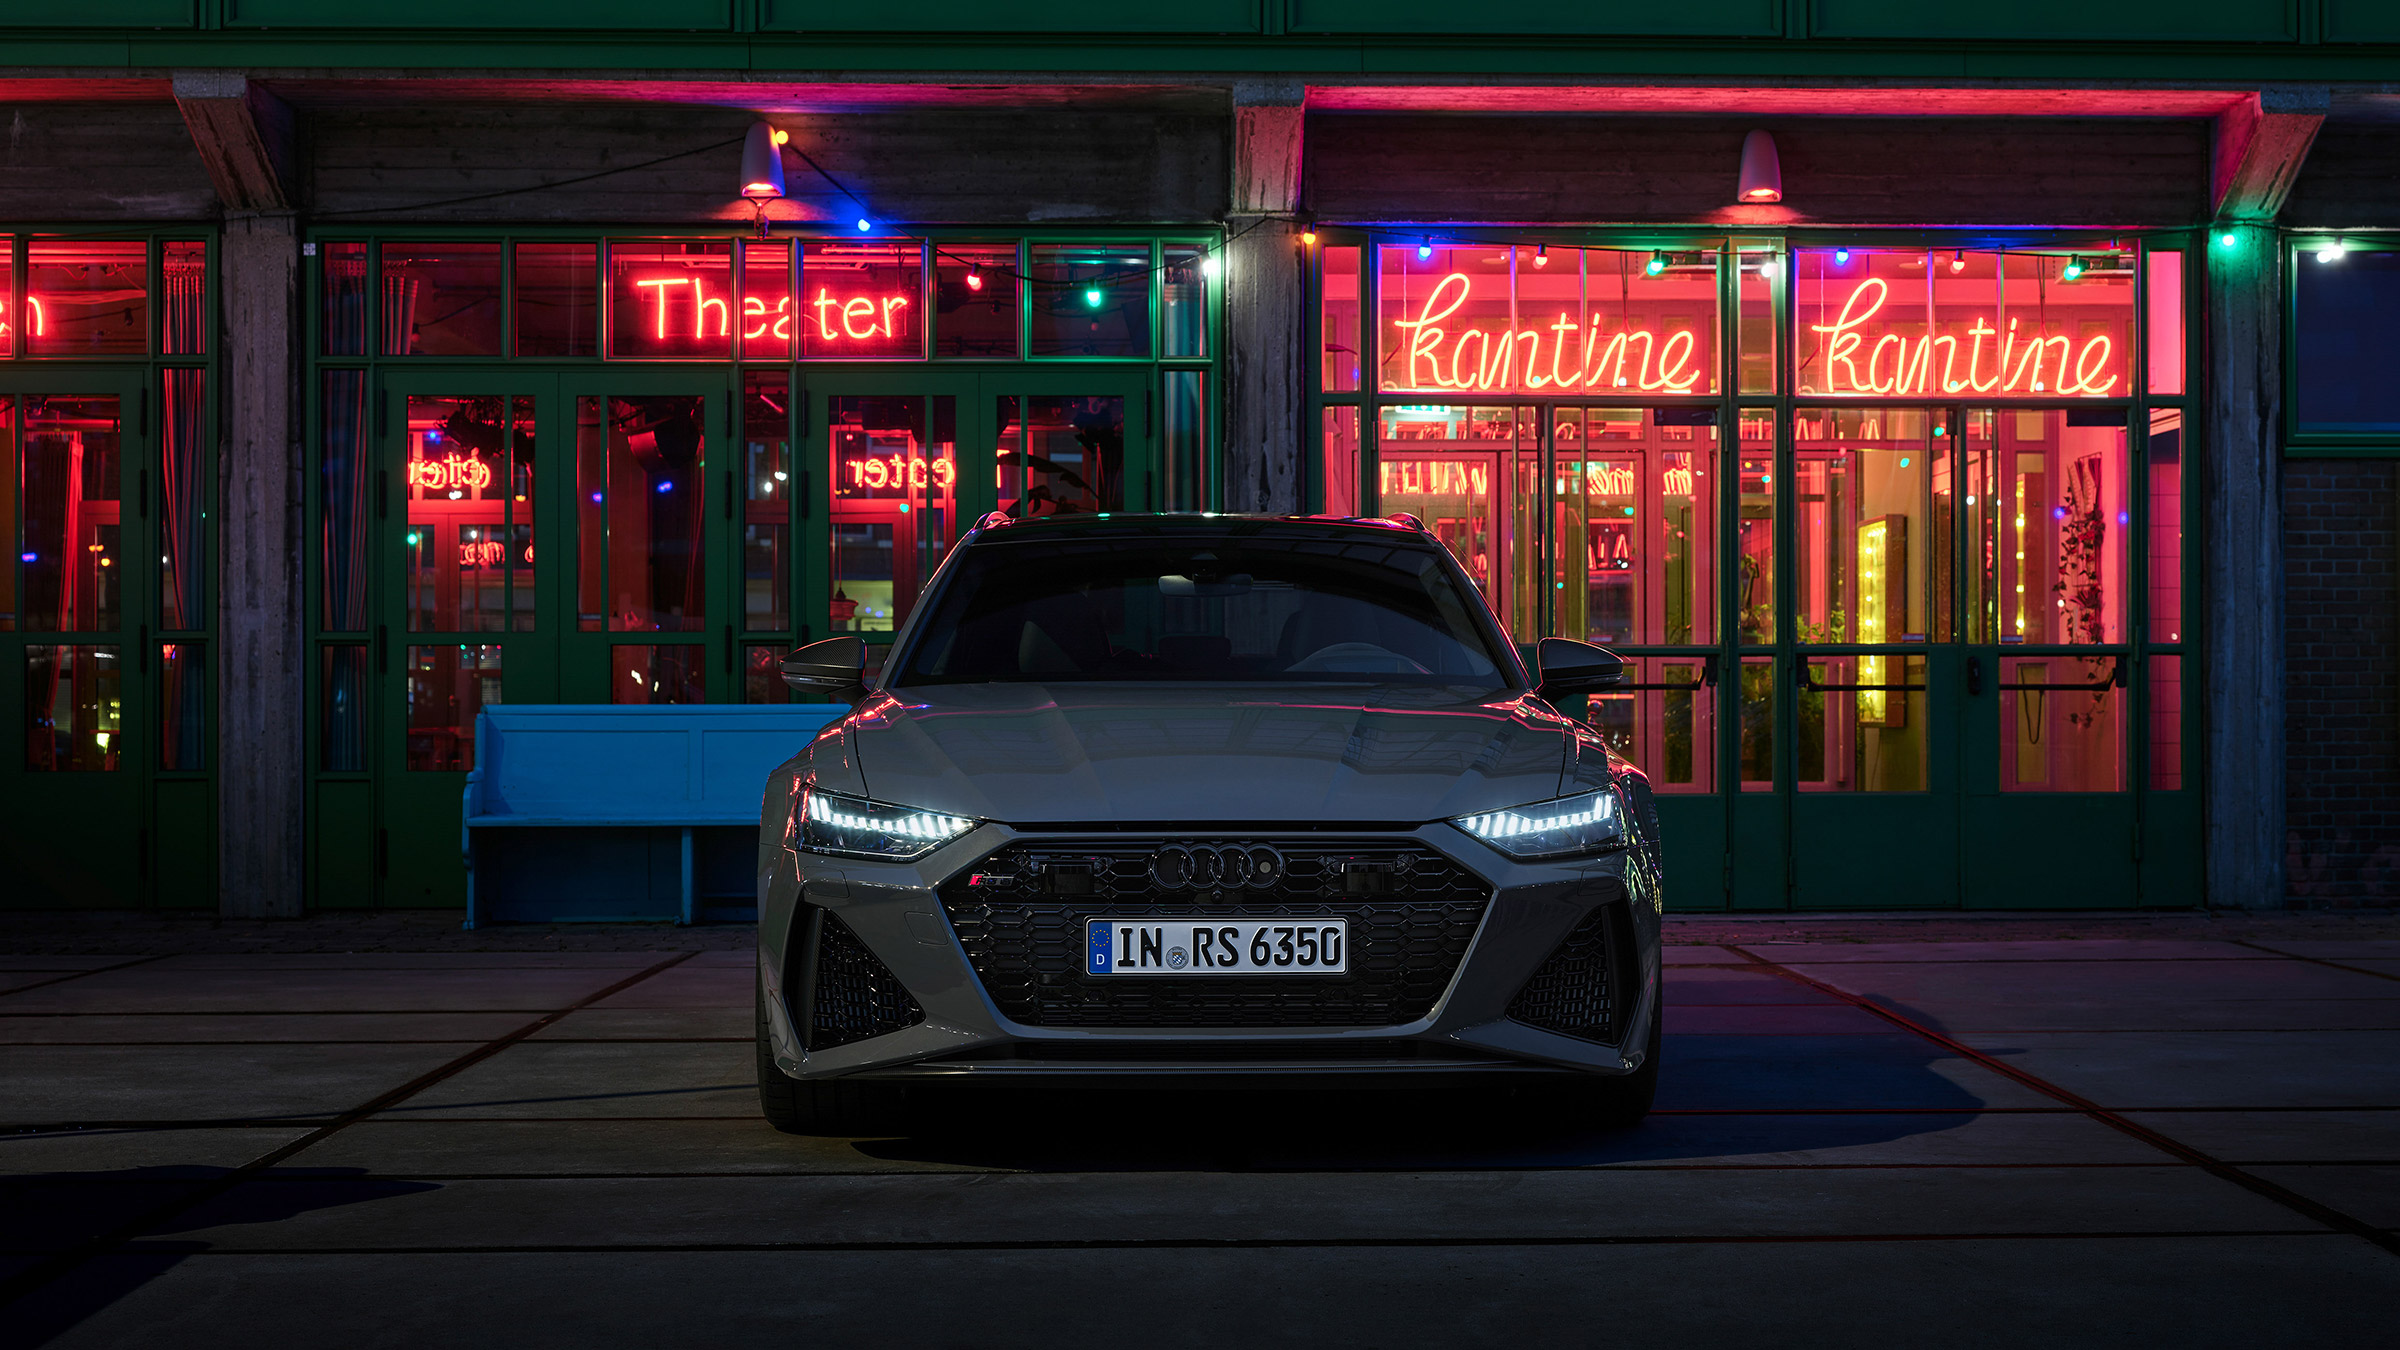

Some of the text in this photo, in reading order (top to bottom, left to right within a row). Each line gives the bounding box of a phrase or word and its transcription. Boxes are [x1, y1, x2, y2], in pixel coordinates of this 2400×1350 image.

[637, 278, 908, 340] Theater
[1394, 273, 1701, 390] kantine
[1811, 277, 2118, 395] kantine
[1096, 954, 1105, 965] D
[1117, 927, 1162, 967] IN
[1193, 927, 1239, 967] RS
[1250, 926, 1341, 967] 6350
